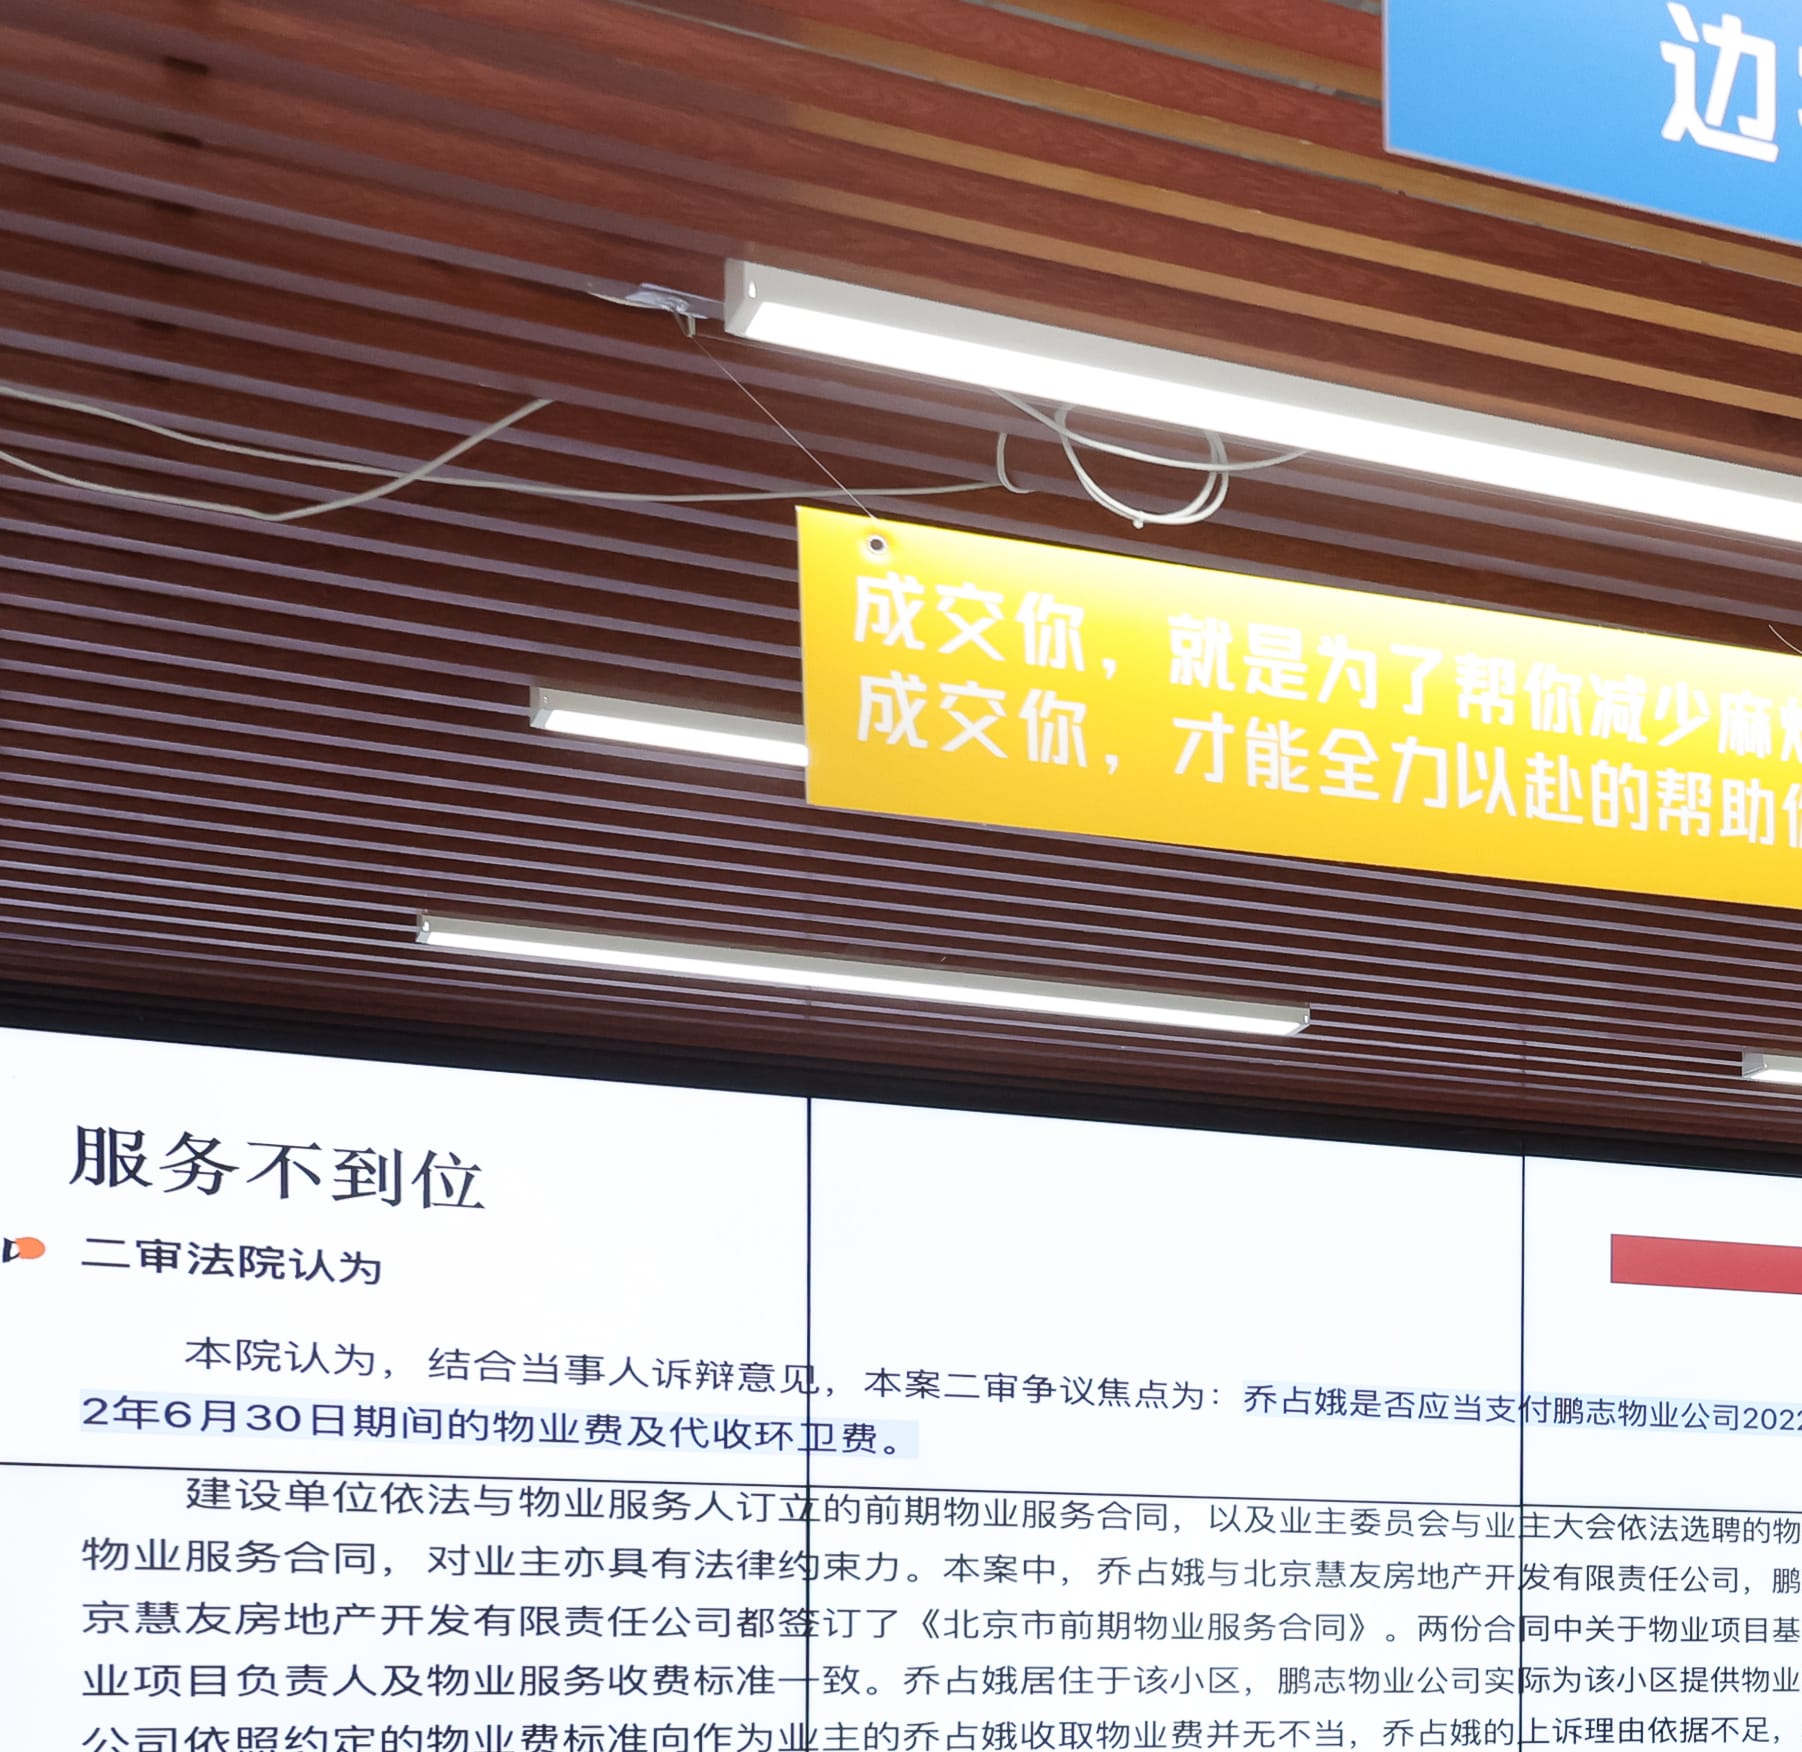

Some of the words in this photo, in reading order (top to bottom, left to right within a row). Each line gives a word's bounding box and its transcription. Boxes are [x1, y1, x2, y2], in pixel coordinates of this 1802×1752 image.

[69, 1124, 486, 1210] 服务不到位
[81, 1237, 383, 1287] 二审法院认为
[81, 1394, 898, 1457] 2年6月30日期间的物业费及代收环卫费。
